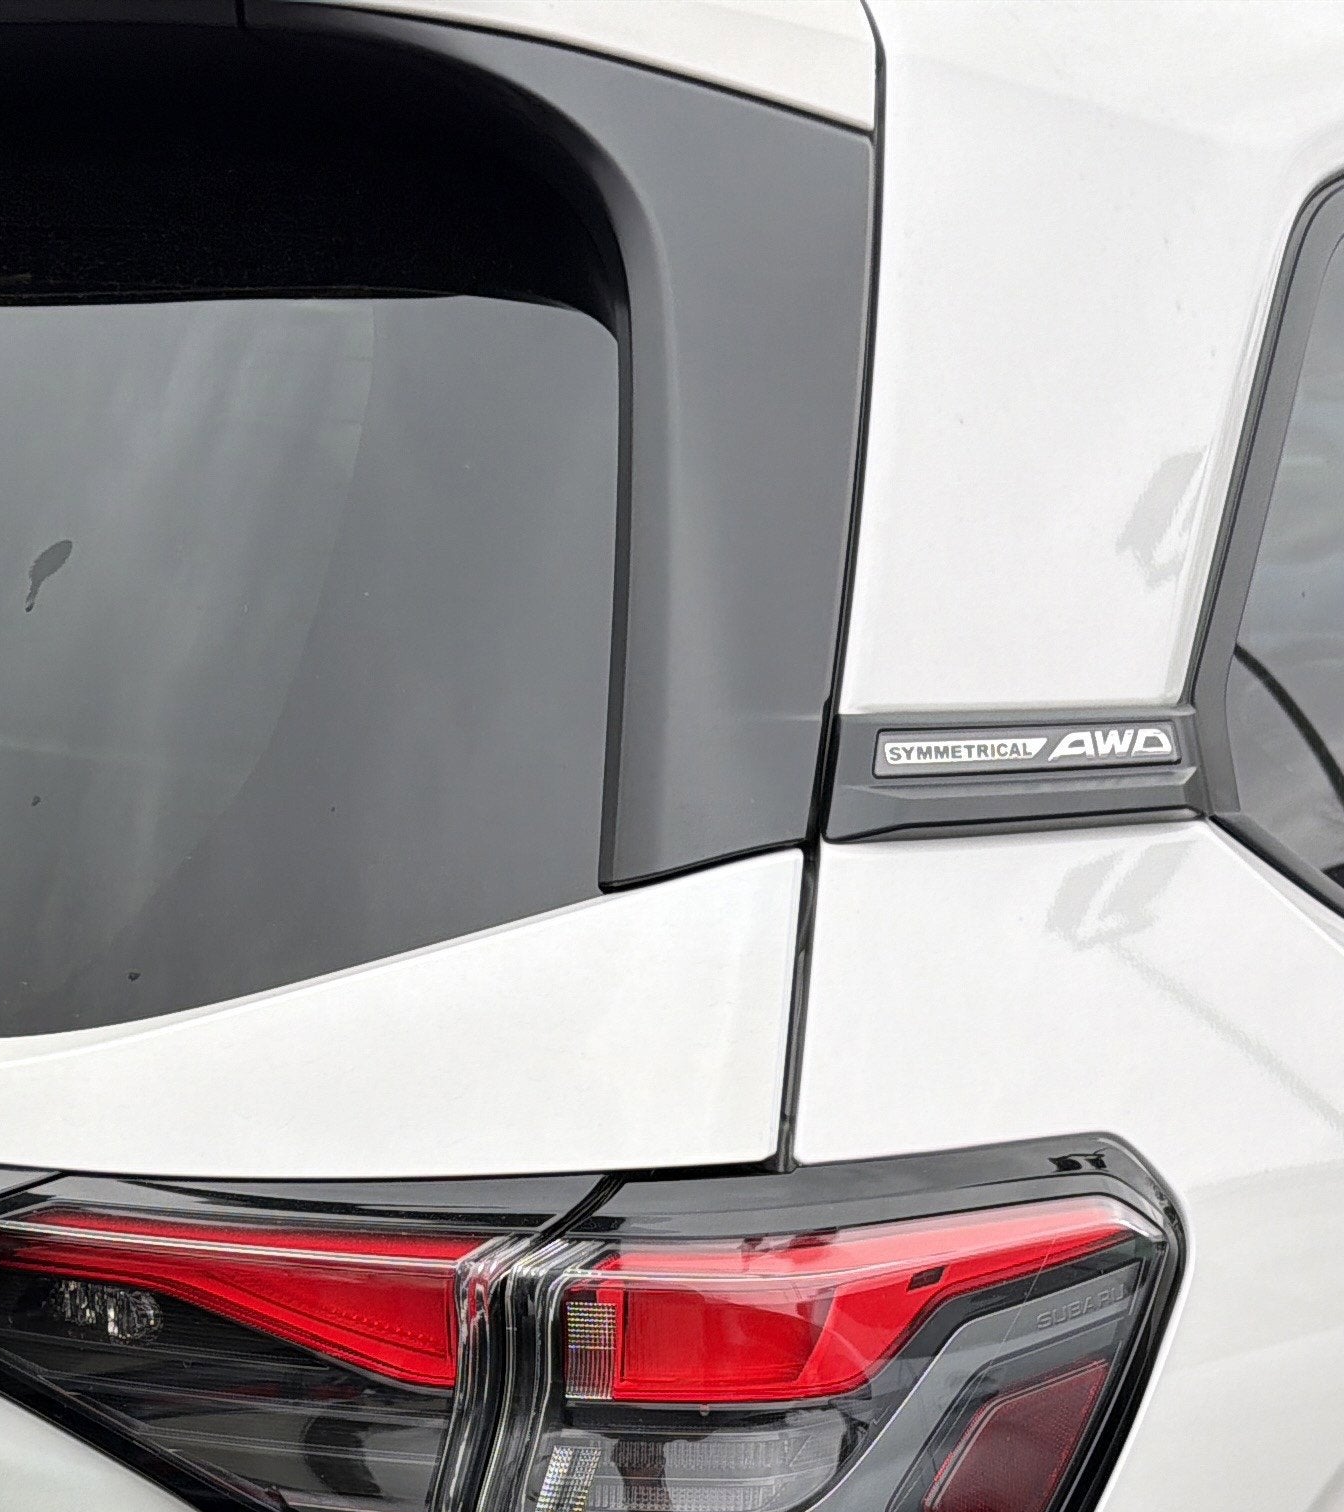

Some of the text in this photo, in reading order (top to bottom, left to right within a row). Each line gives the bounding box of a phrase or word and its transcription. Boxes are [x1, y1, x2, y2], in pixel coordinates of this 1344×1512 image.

[888, 728, 1173, 763] SYMMETRICAL AWD
[1036, 1282, 1125, 1330] SUBARU
